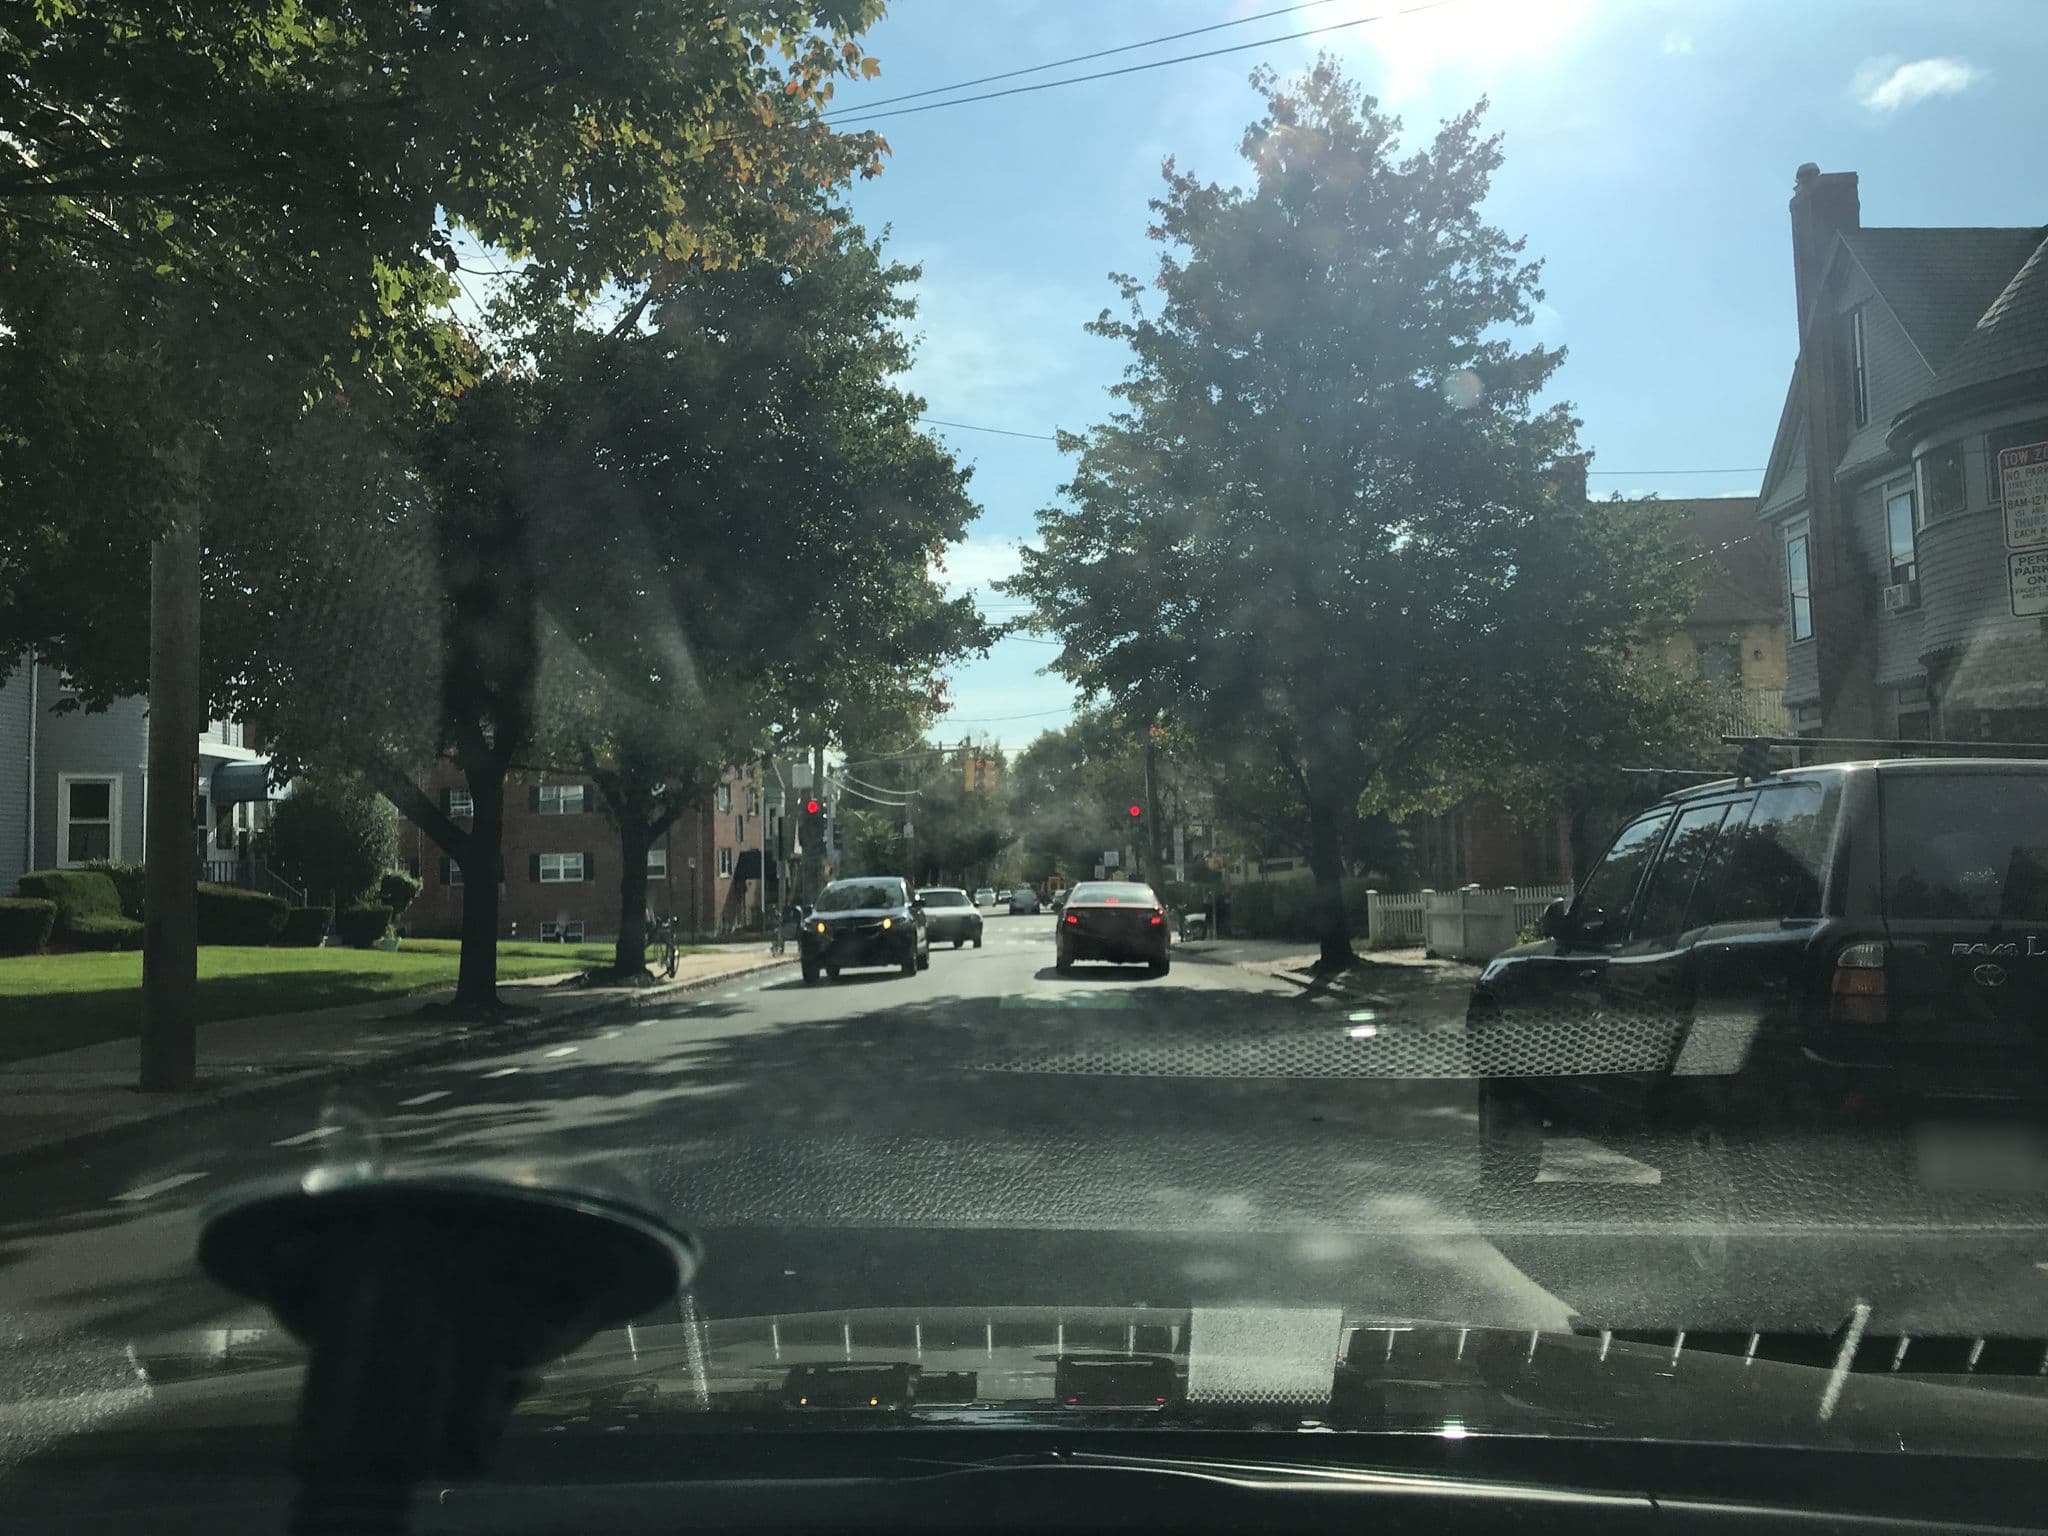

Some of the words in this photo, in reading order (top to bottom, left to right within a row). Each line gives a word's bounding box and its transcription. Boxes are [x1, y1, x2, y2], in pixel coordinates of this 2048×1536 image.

[2002, 450, 2029, 466] TOW
[2006, 471, 2020, 482] NO
[2014, 528, 2037, 539] EACH
